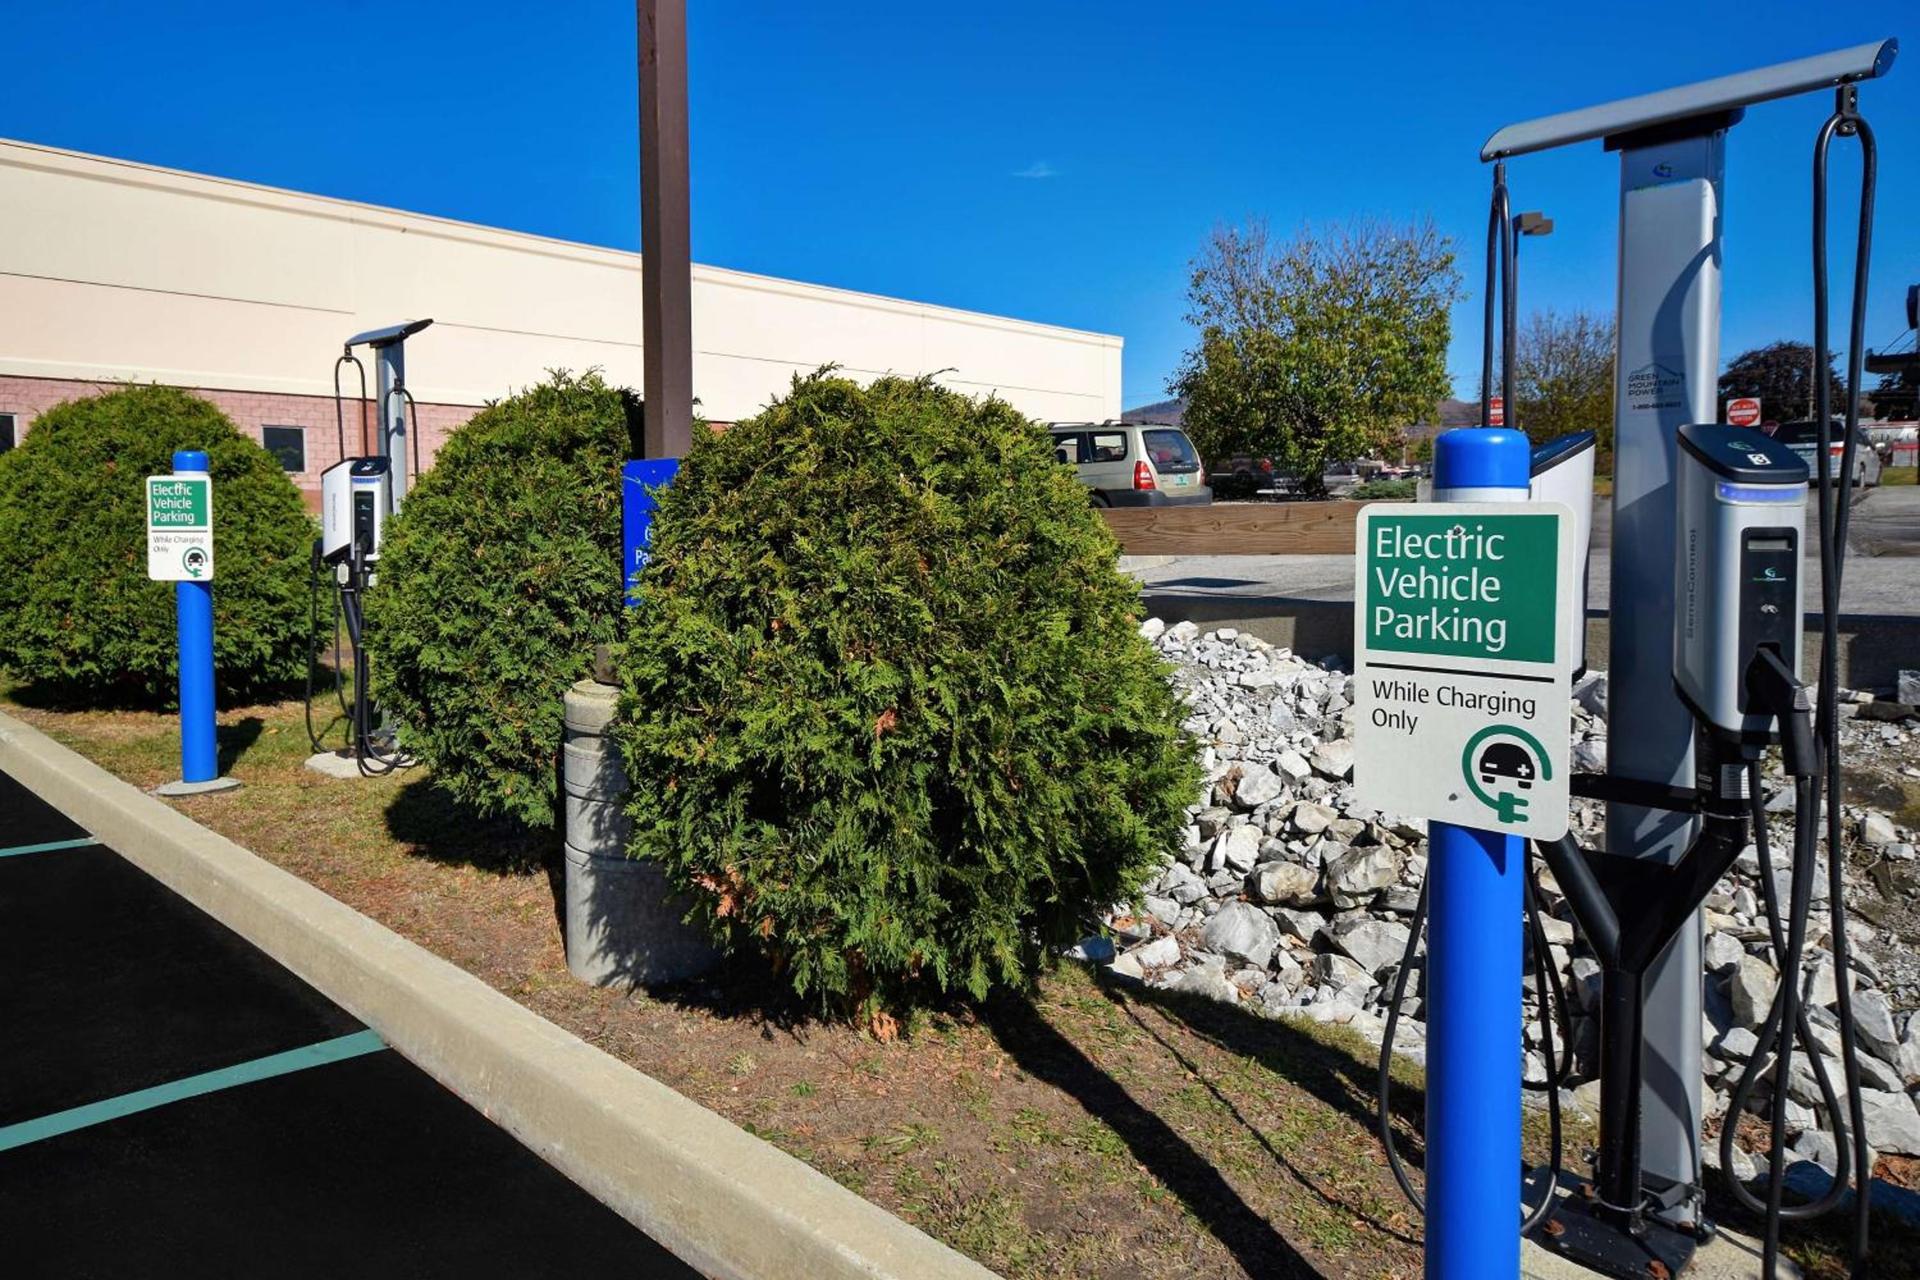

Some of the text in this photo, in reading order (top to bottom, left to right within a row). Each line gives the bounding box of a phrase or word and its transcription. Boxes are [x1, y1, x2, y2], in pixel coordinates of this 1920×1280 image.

[153, 484, 192, 495] Electric
[153, 498, 193, 509] Vehicle
[153, 511, 194, 524] Parking
[1376, 525, 1505, 560] Electric
[1376, 566, 1501, 602] Vehicle
[1375, 606, 1507, 652] Parking
[1372, 680, 1536, 719] While Charging
[1372, 708, 1418, 735] Only
